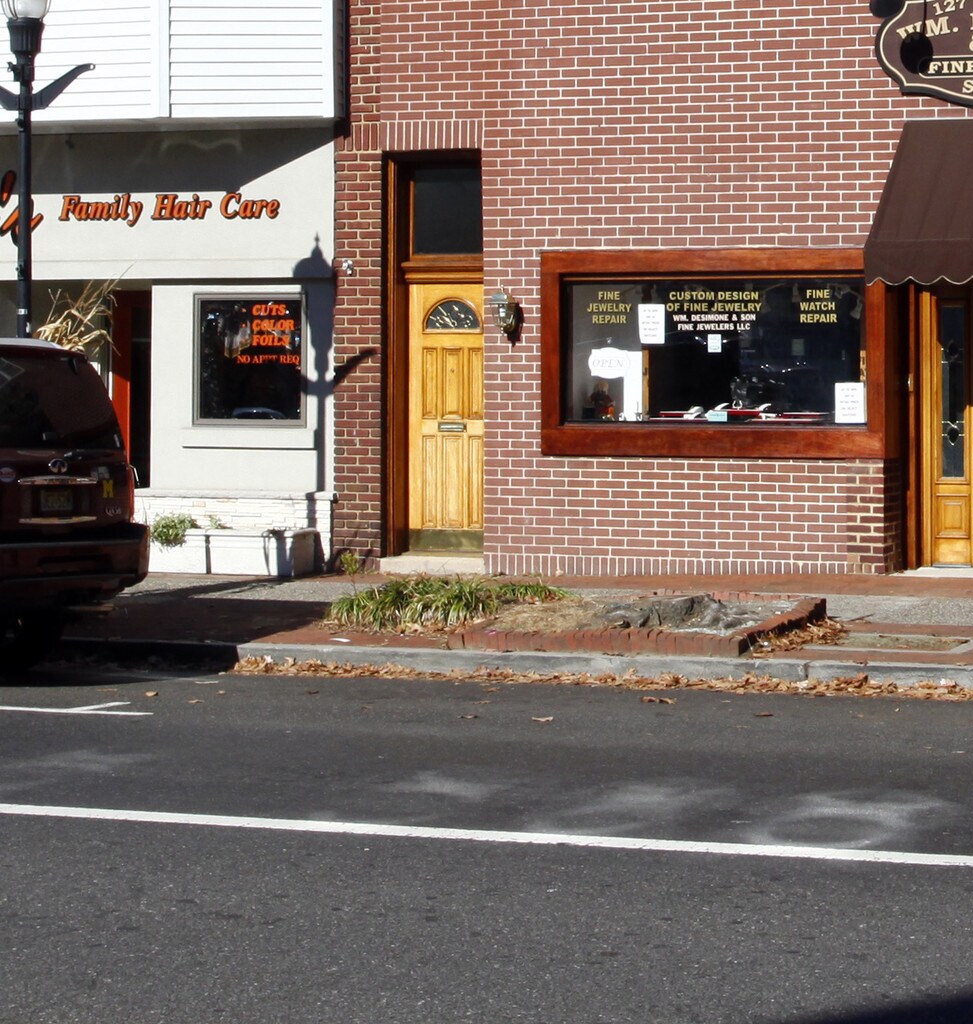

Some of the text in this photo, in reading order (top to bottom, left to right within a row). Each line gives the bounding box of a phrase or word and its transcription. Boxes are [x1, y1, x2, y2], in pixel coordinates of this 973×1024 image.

[58, 192, 144, 227] Family
[150, 193, 213, 221] Hair
[219, 192, 281, 220] Care
[598, 291, 621, 301] FINE
[669, 291, 759, 301] CUSTOM DESIGN
[806, 289, 830, 299] FINE
[252, 304, 287, 316] CUTS
[586, 303, 632, 313] JEWELRY
[666, 302, 763, 312] OF FINE JEWELRY
[800, 301, 836, 311] WATCH
[592, 314, 627, 324] REPAIR
[673, 314, 689, 322] WM.
[691, 313, 729, 321] DESIMONE
[740, 313, 756, 321] SON
[799, 313, 838, 323] REPAIR
[252, 319, 295, 331] COLOR
[677, 323, 751, 331] FINE JEWELERS LLC
[252, 334, 291, 346] FOILS
[236, 354, 251, 364] NO
[279, 354, 301, 365] REQ
[592, 358, 625, 368] OPEN
